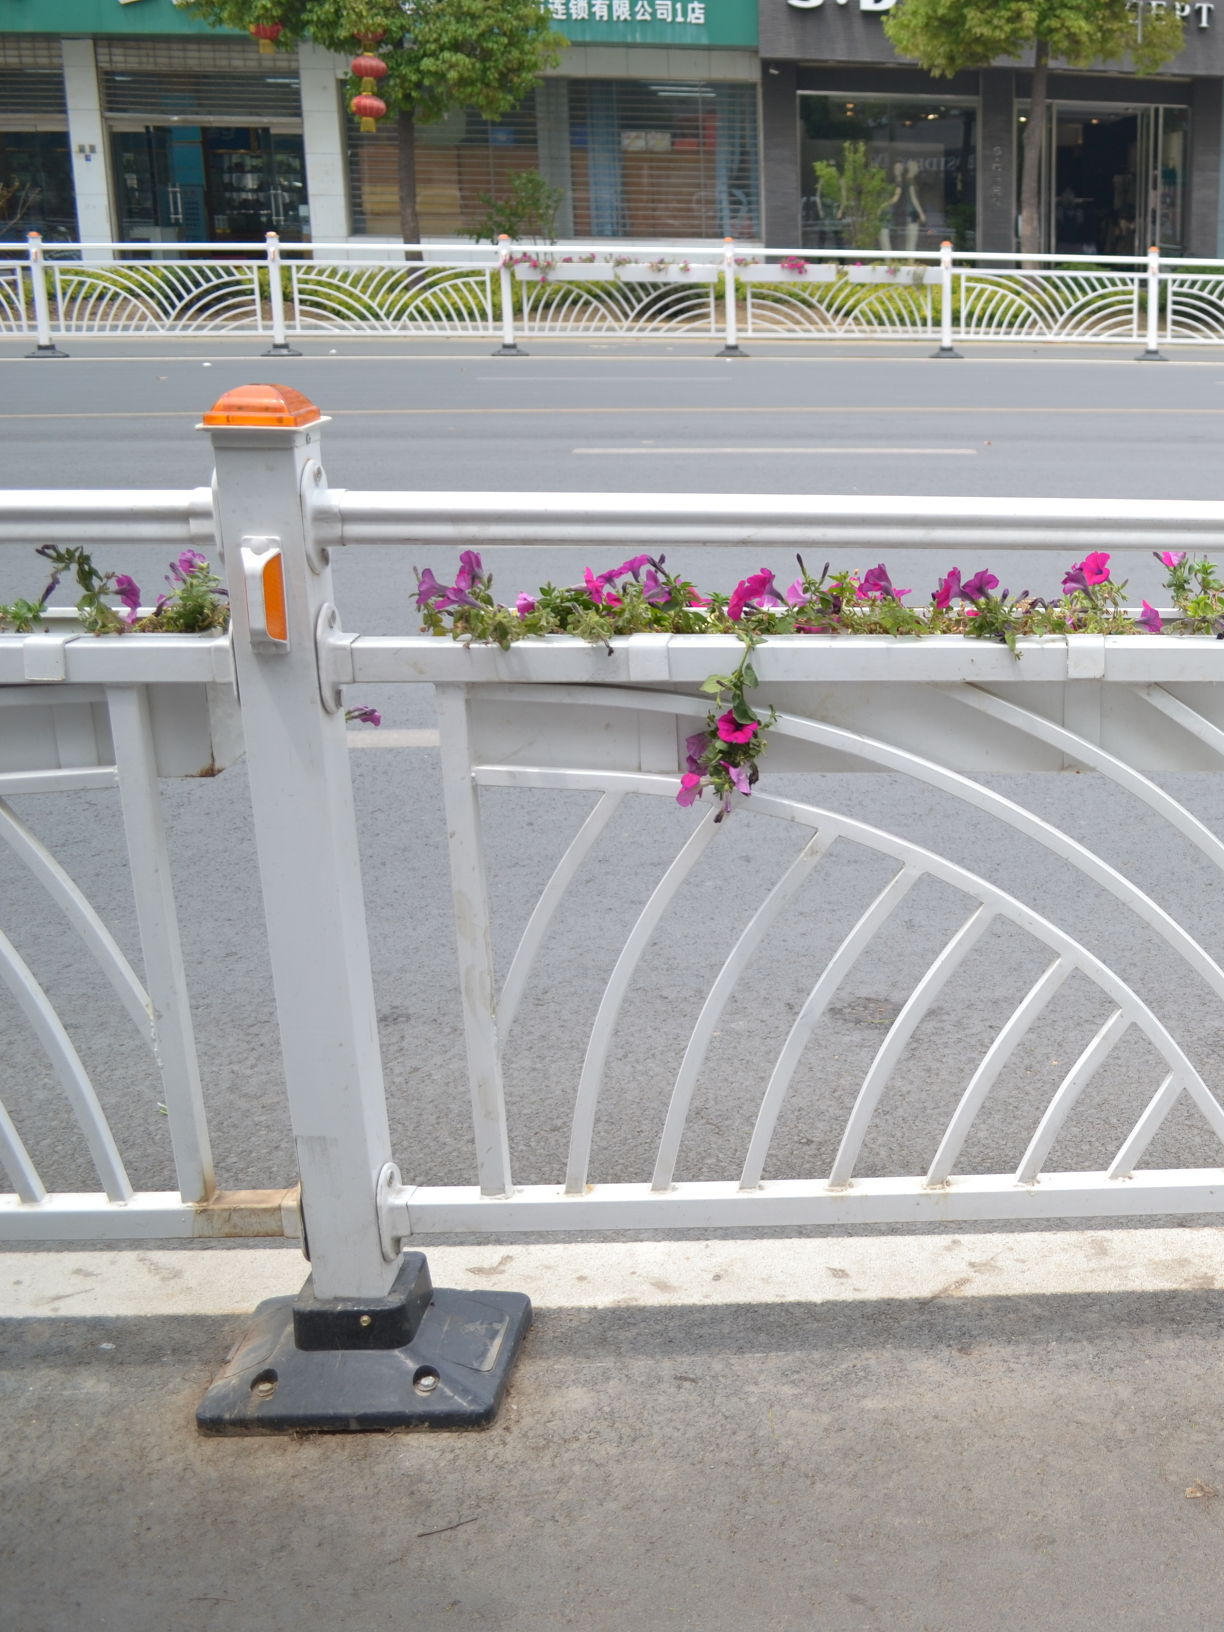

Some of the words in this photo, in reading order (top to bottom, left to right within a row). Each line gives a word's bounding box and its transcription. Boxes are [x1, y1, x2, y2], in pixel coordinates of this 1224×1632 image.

[539, 0, 705, 24] 连锁有限公司1店
